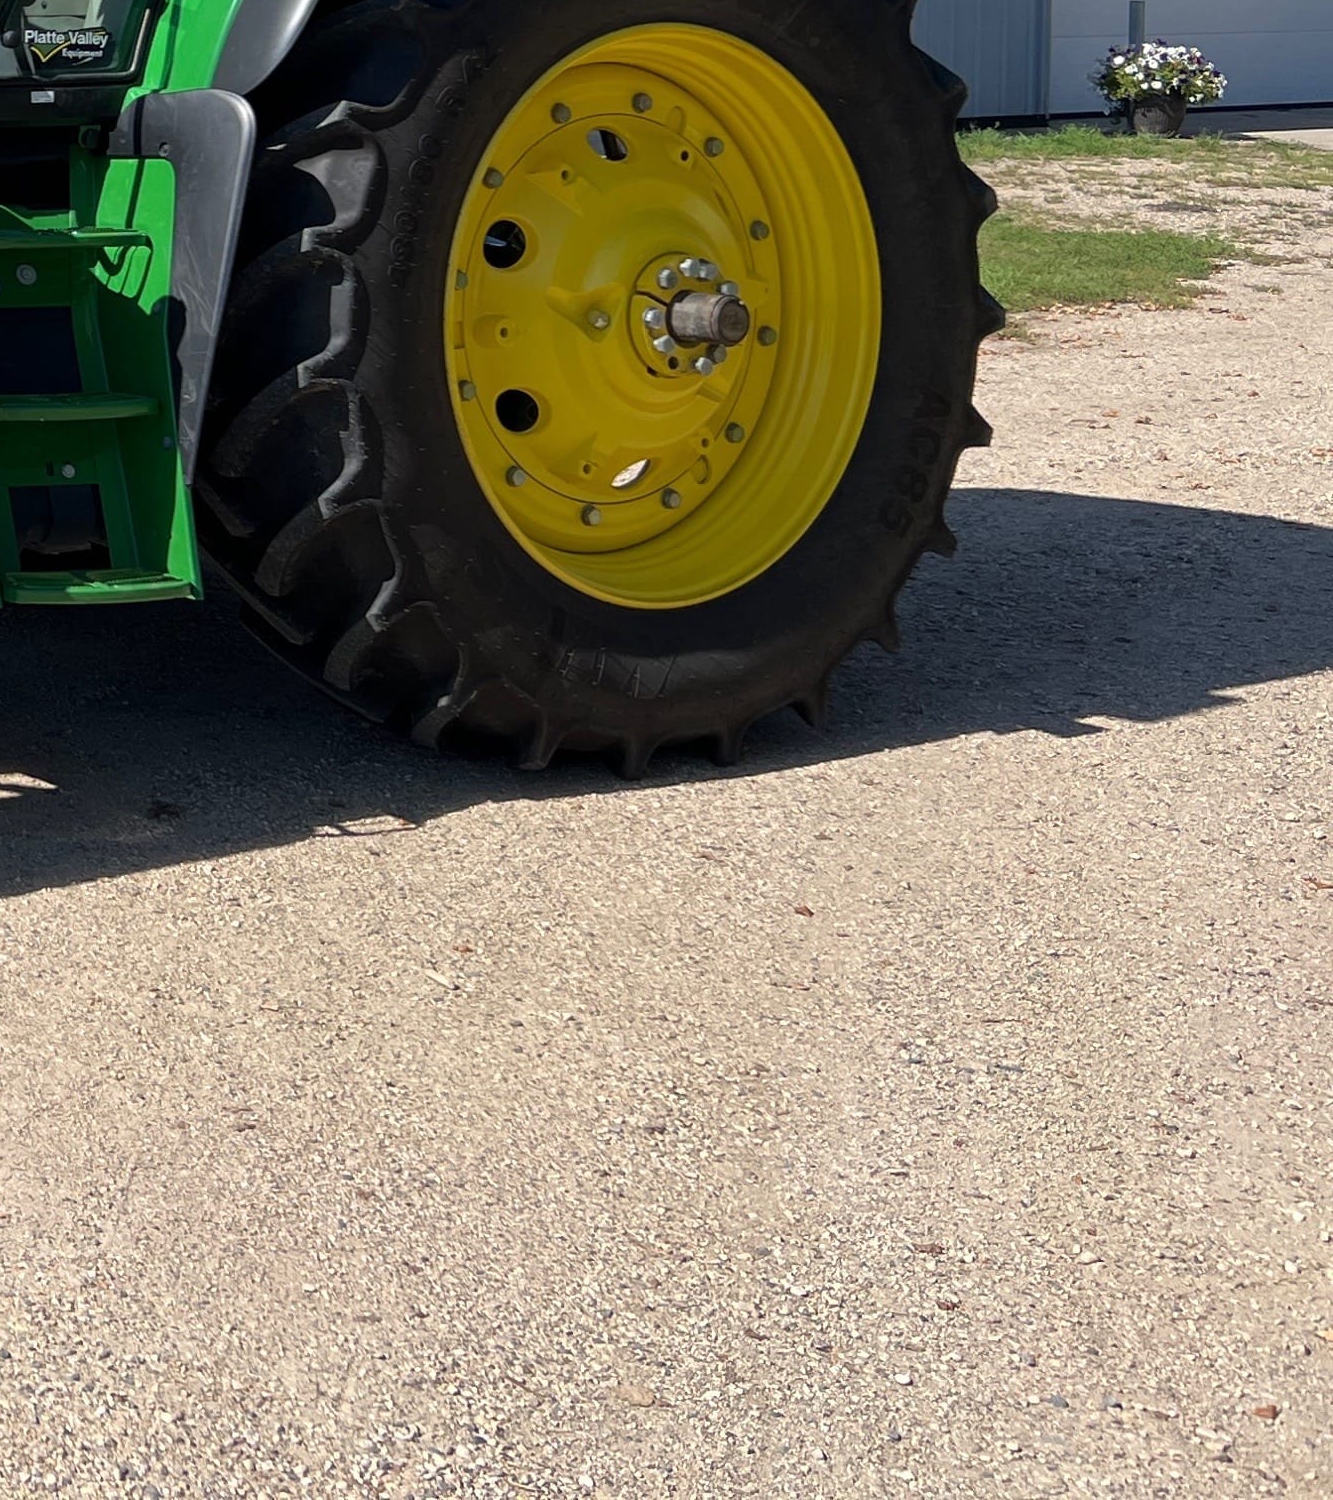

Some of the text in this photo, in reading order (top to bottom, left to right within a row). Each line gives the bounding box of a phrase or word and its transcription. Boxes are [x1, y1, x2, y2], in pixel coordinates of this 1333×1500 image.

[24, 29, 109, 49] Platte Valley
[61, 47, 104, 60] Equipment
